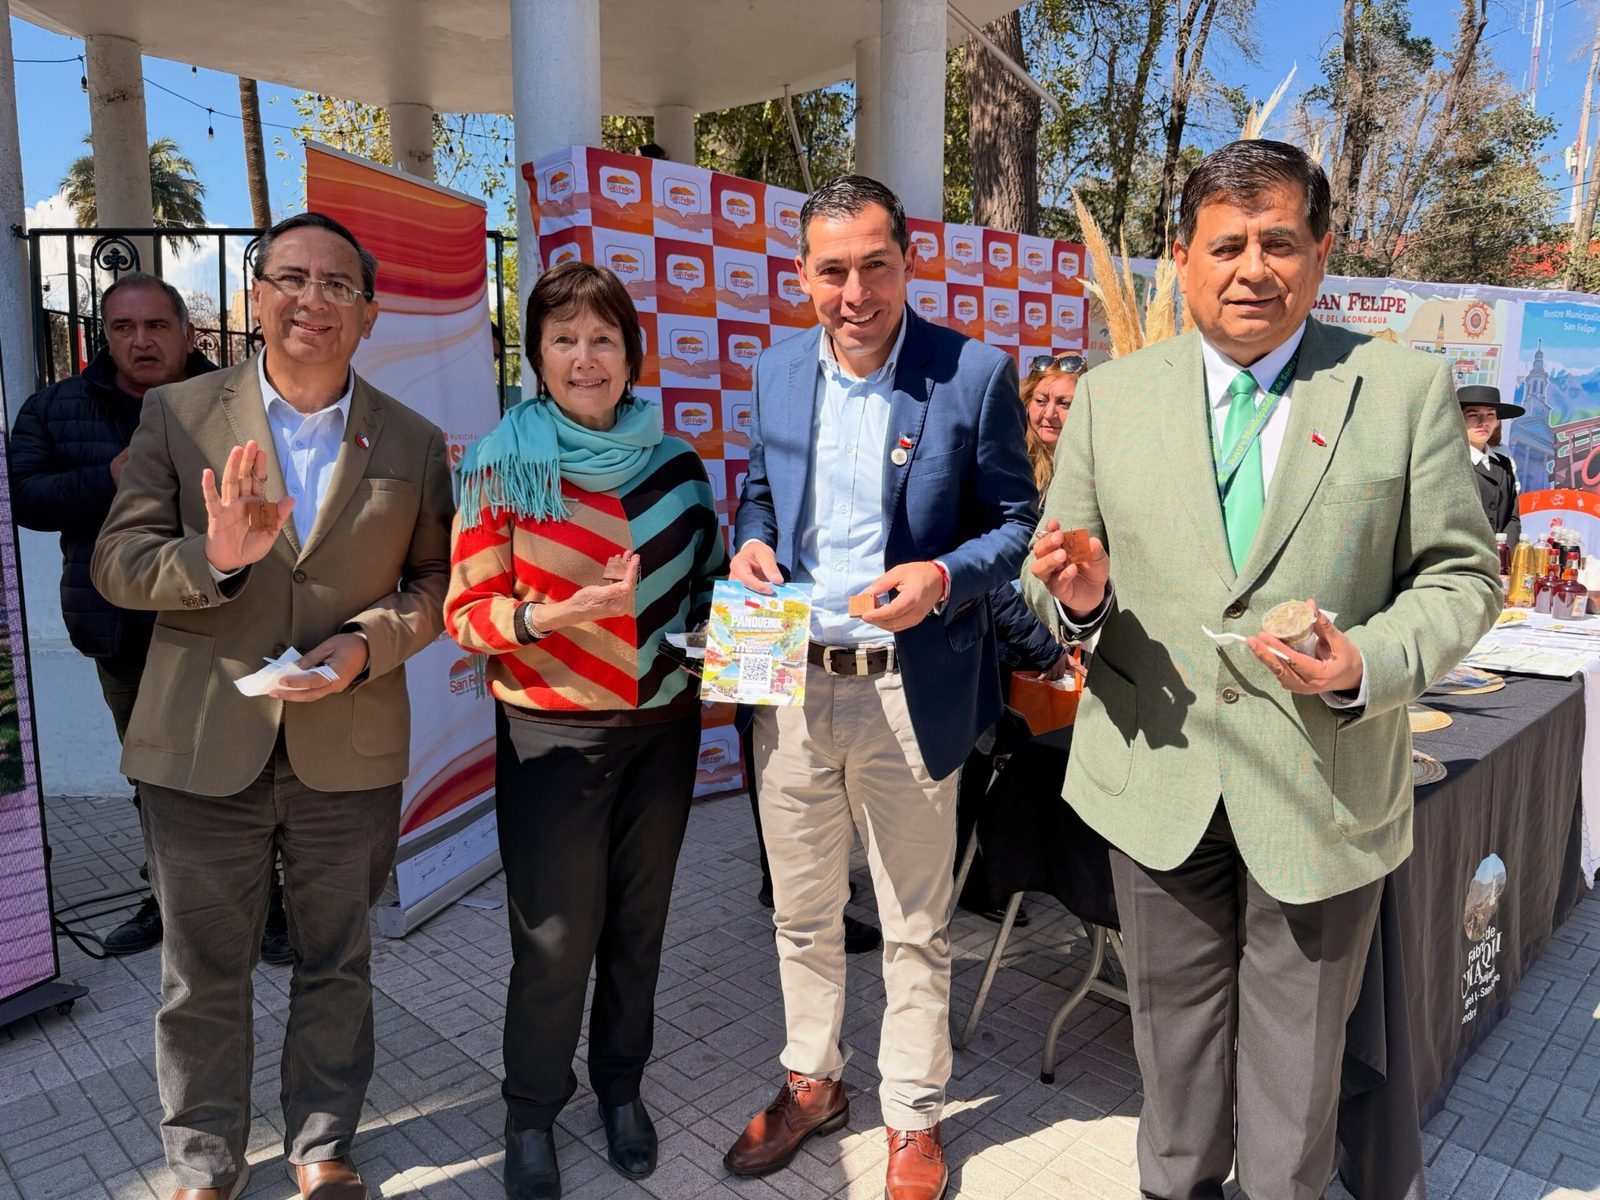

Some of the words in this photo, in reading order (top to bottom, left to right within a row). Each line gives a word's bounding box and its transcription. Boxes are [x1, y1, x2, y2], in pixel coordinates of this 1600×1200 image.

[1347, 292, 1406, 314] FELIPE
[1326, 314, 1338, 322] DEL
[1342, 315, 1388, 324] ACONCAGUA
[449, 679, 468, 694] San
[1486, 925, 1496, 940] de
